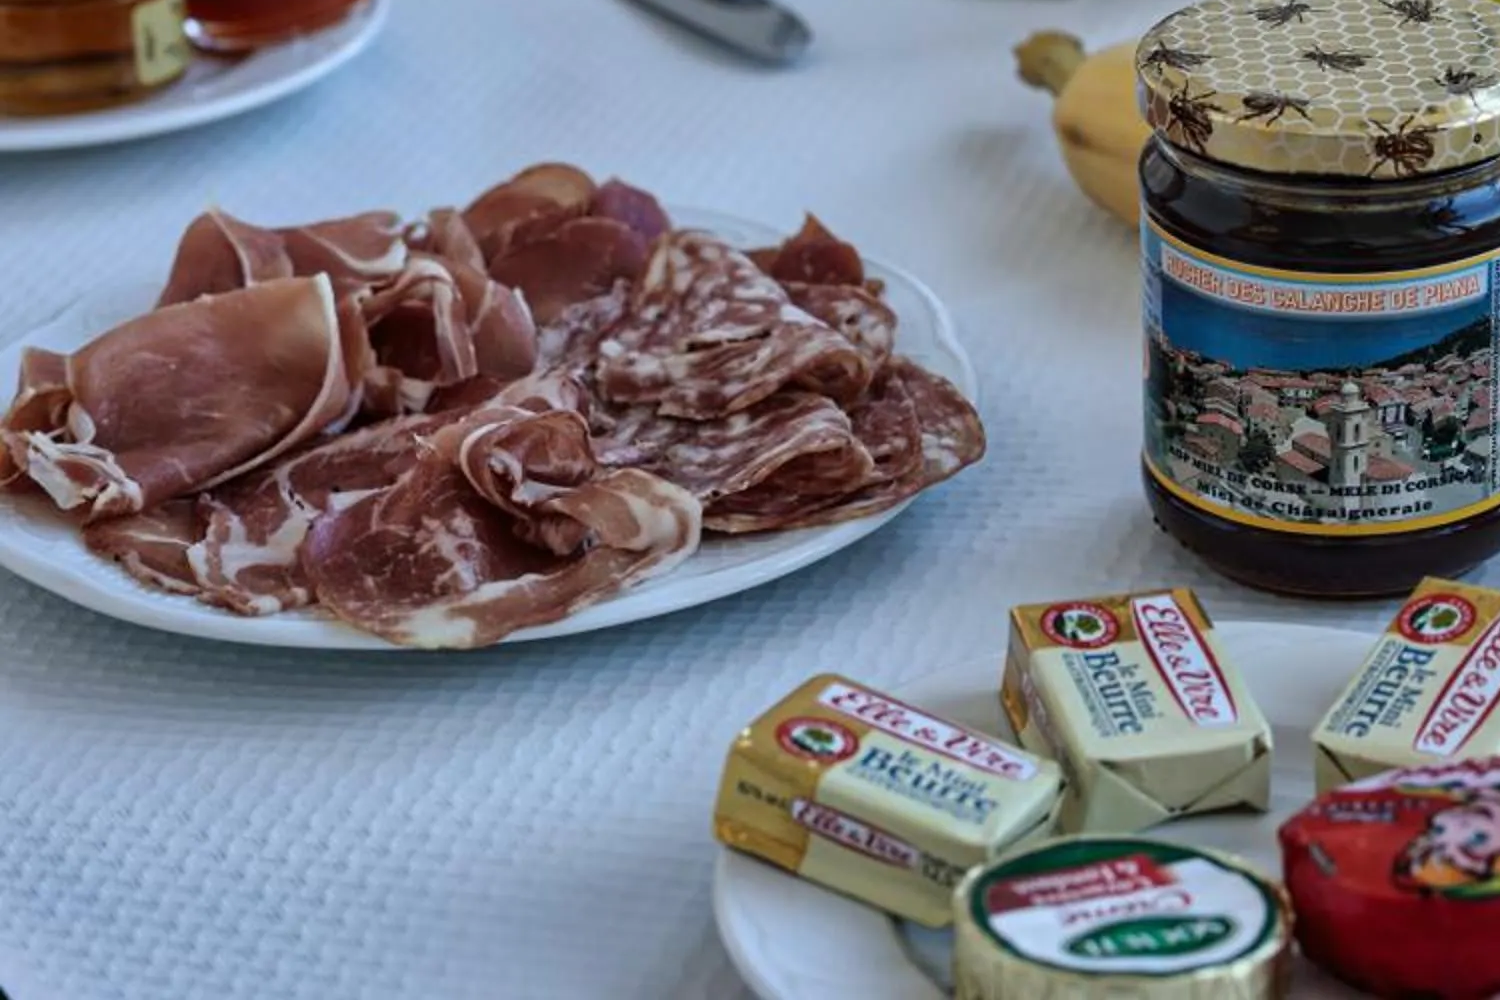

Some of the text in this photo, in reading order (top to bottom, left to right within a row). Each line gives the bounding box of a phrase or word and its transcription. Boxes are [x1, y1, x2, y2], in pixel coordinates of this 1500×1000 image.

[1166, 255, 1481, 313] RUCHER DES CALANCHE DE PIANA
[1197, 479, 1235, 503] Miel
[1227, 471, 1249, 487] DE
[1250, 477, 1306, 495] CORSE
[1329, 485, 1377, 497] MELE
[1381, 482, 1400, 495] DI
[1083, 651, 1144, 736] Beurre
[1141, 602, 1190, 659] Elle
[1176, 668, 1220, 720] Vire
[1345, 645, 1437, 738] Beurre
[1463, 668, 1488, 690] &
[830, 690, 912, 729] Elle
[944, 732, 1025, 778] Vire
[1423, 684, 1486, 747] Vire
[859, 745, 998, 812] Beurre
